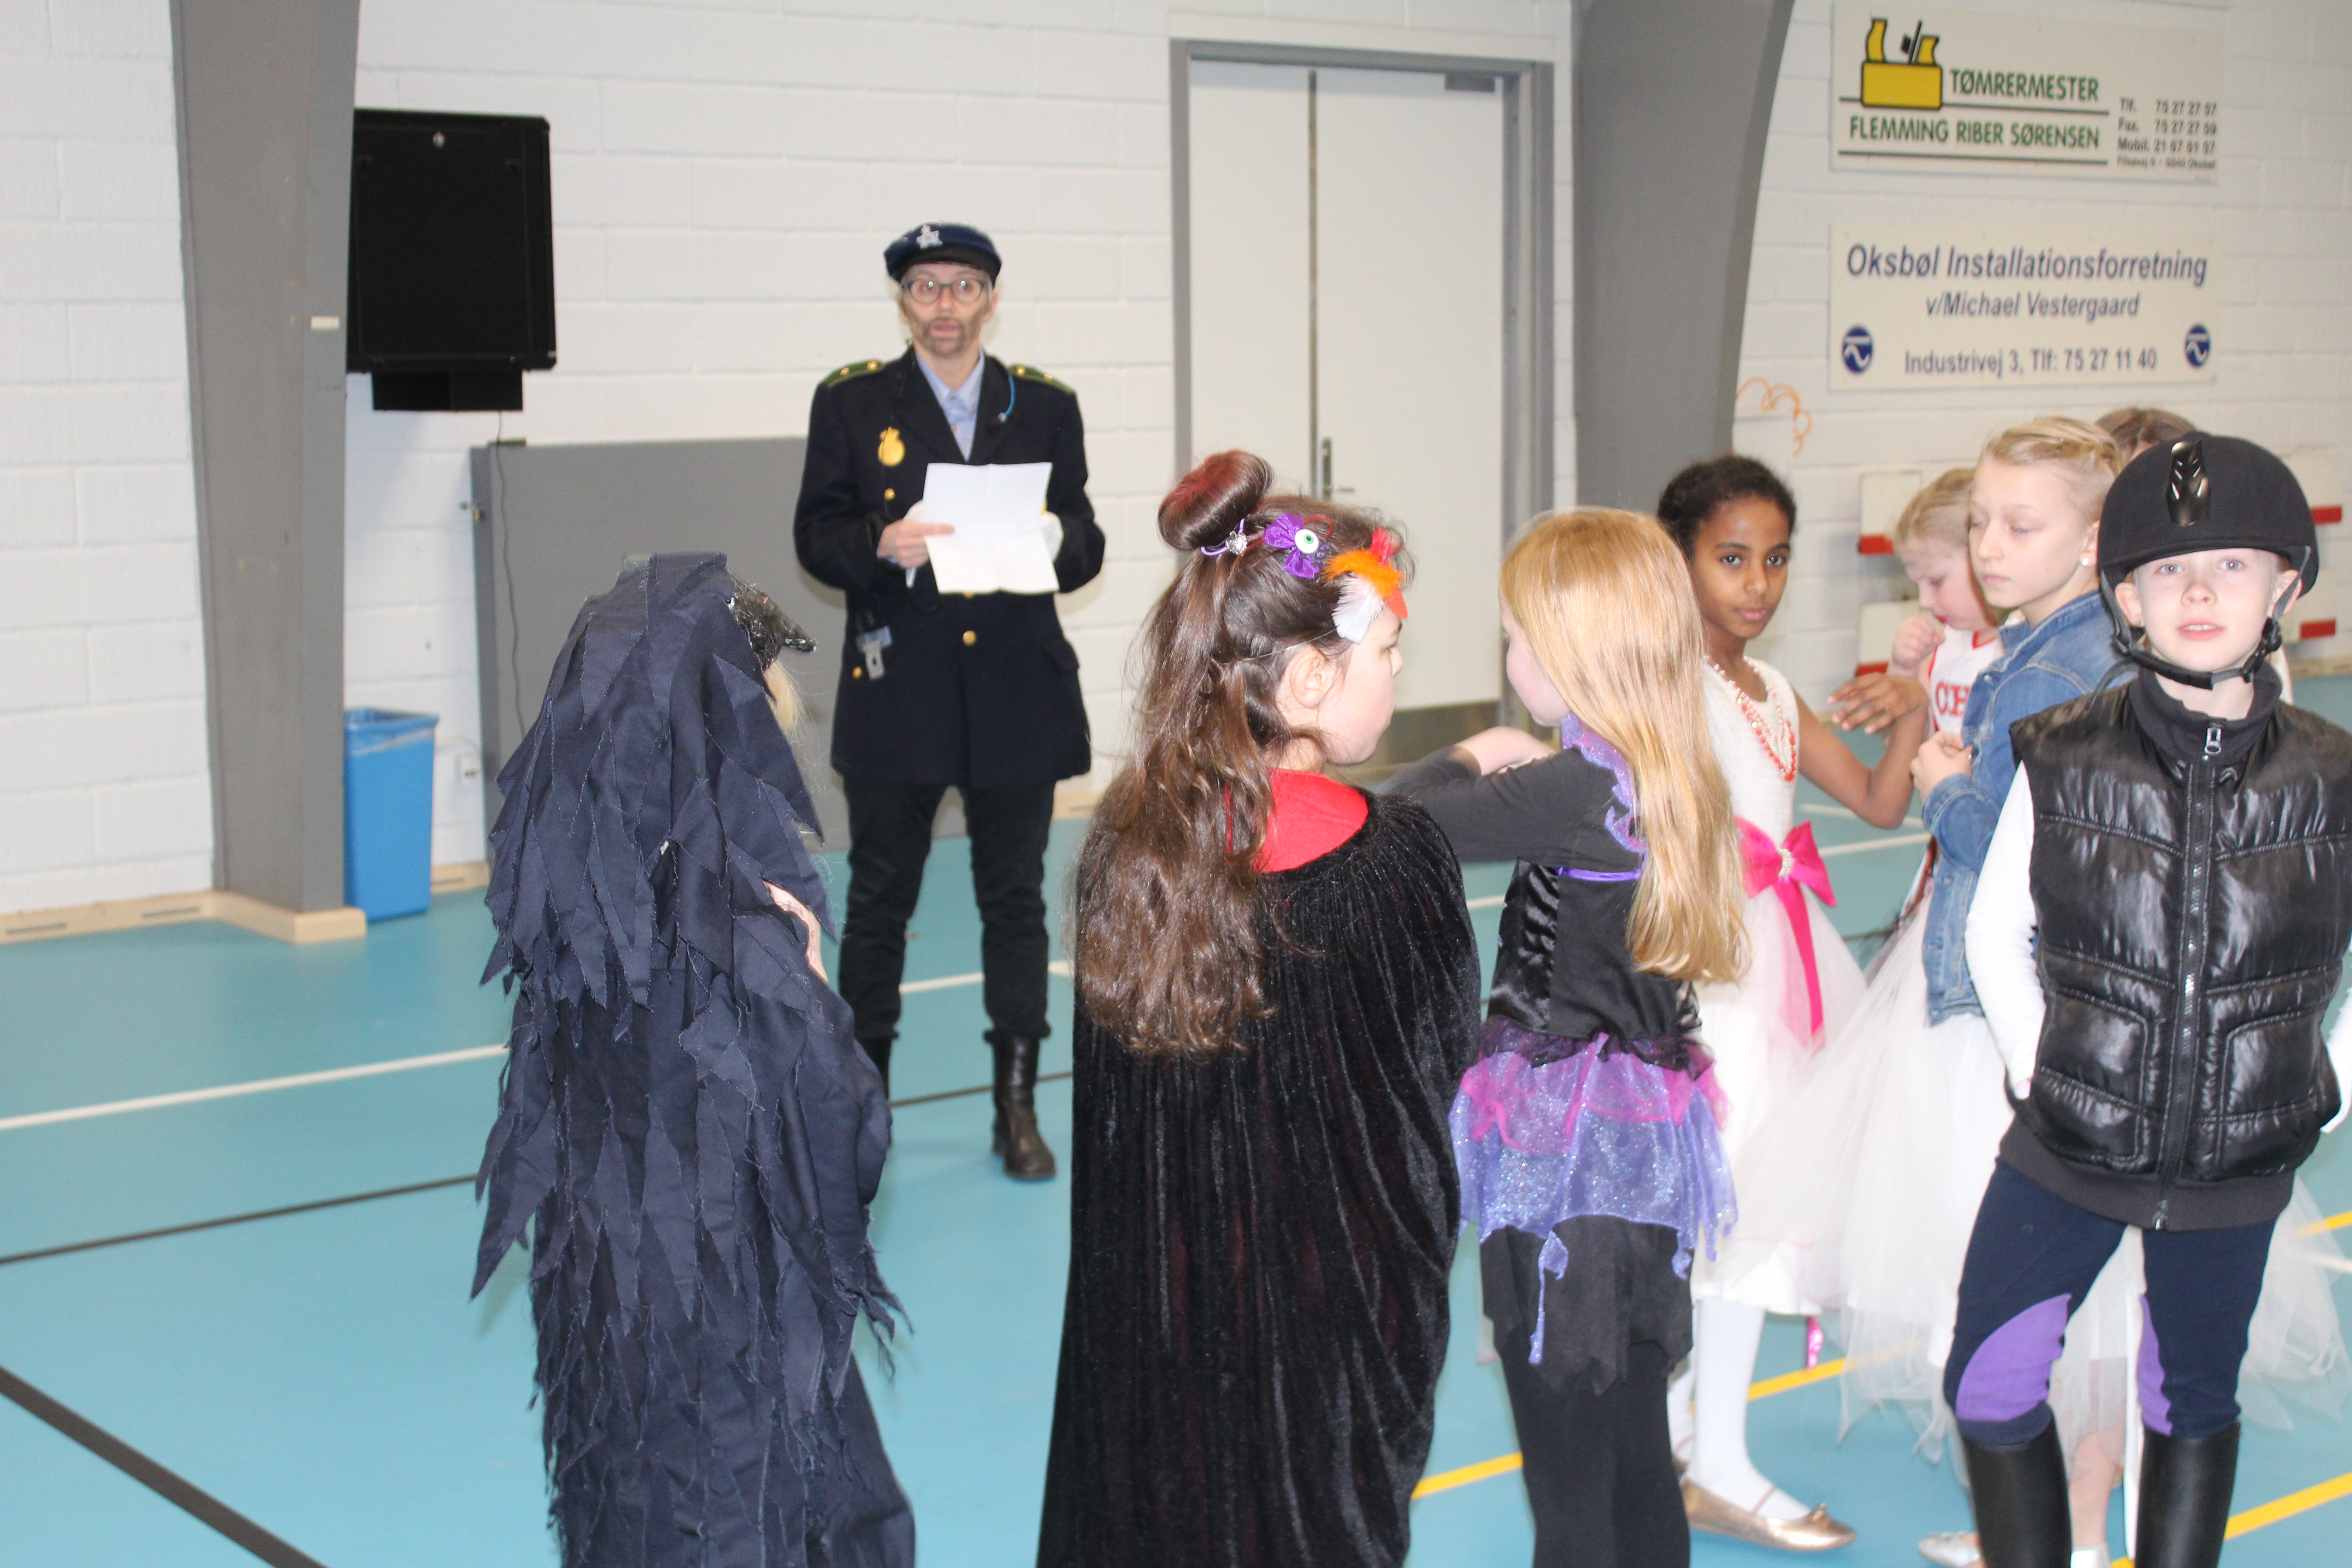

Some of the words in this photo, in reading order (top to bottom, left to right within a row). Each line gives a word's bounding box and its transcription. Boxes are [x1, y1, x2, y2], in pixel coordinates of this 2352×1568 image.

[1950, 69, 2099, 101] TØMRERMESTER
[2172, 100, 2185, 114] 27
[2188, 101, 2200, 115] 27
[1850, 115, 1949, 142] FLEMMING
[1957, 120, 2004, 144] RIBER
[2011, 122, 2099, 148] SØRENSEN
[2171, 119, 2184, 134] 27
[2187, 121, 2200, 135] 27
[1848, 244, 1940, 276] Oksbøl
[1947, 246, 2207, 287] Installationsforretning
[1926, 290, 2020, 316] v/Michael
[2028, 292, 2140, 322] Vestergaard
[1906, 349, 2003, 379] Industrivej
[2009, 348, 2024, 375] 3,
[2031, 348, 2057, 371] Tlf:
[2064, 348, 2084, 371] 75
[2090, 348, 2108, 371] 27
[2115, 348, 2131, 370] 11
[2137, 347, 2157, 369] 40
